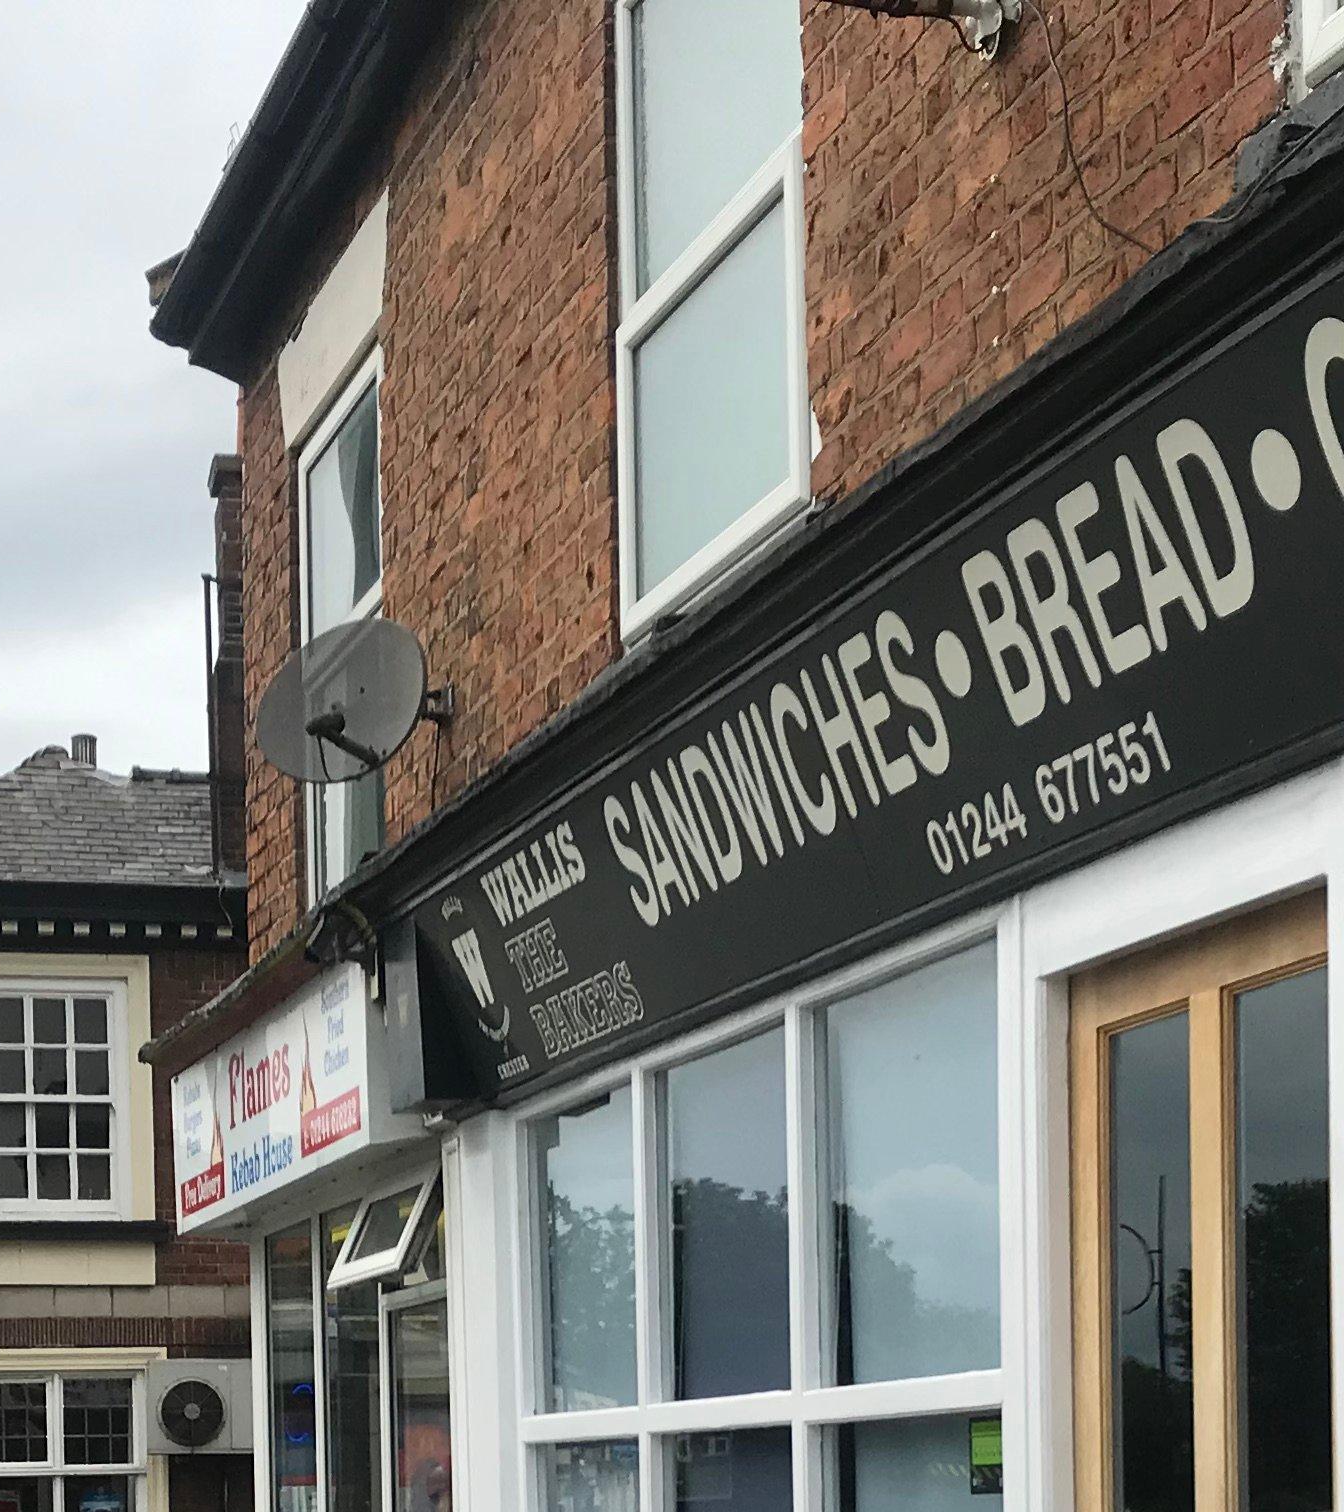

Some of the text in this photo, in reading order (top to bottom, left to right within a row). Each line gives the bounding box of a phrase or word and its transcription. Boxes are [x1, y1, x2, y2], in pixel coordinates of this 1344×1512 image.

[604, 609, 952, 927] SANDWICHES
[962, 419, 1254, 726] BREAD
[927, 711, 1171, 874] 01244 677551
[480, 821, 585, 926] WALLIS
[505, 917, 569, 994] THE
[530, 961, 644, 1059] BAKERS
[228, 1043, 291, 1130] Flames
[231, 1130, 293, 1194] Kebab House
